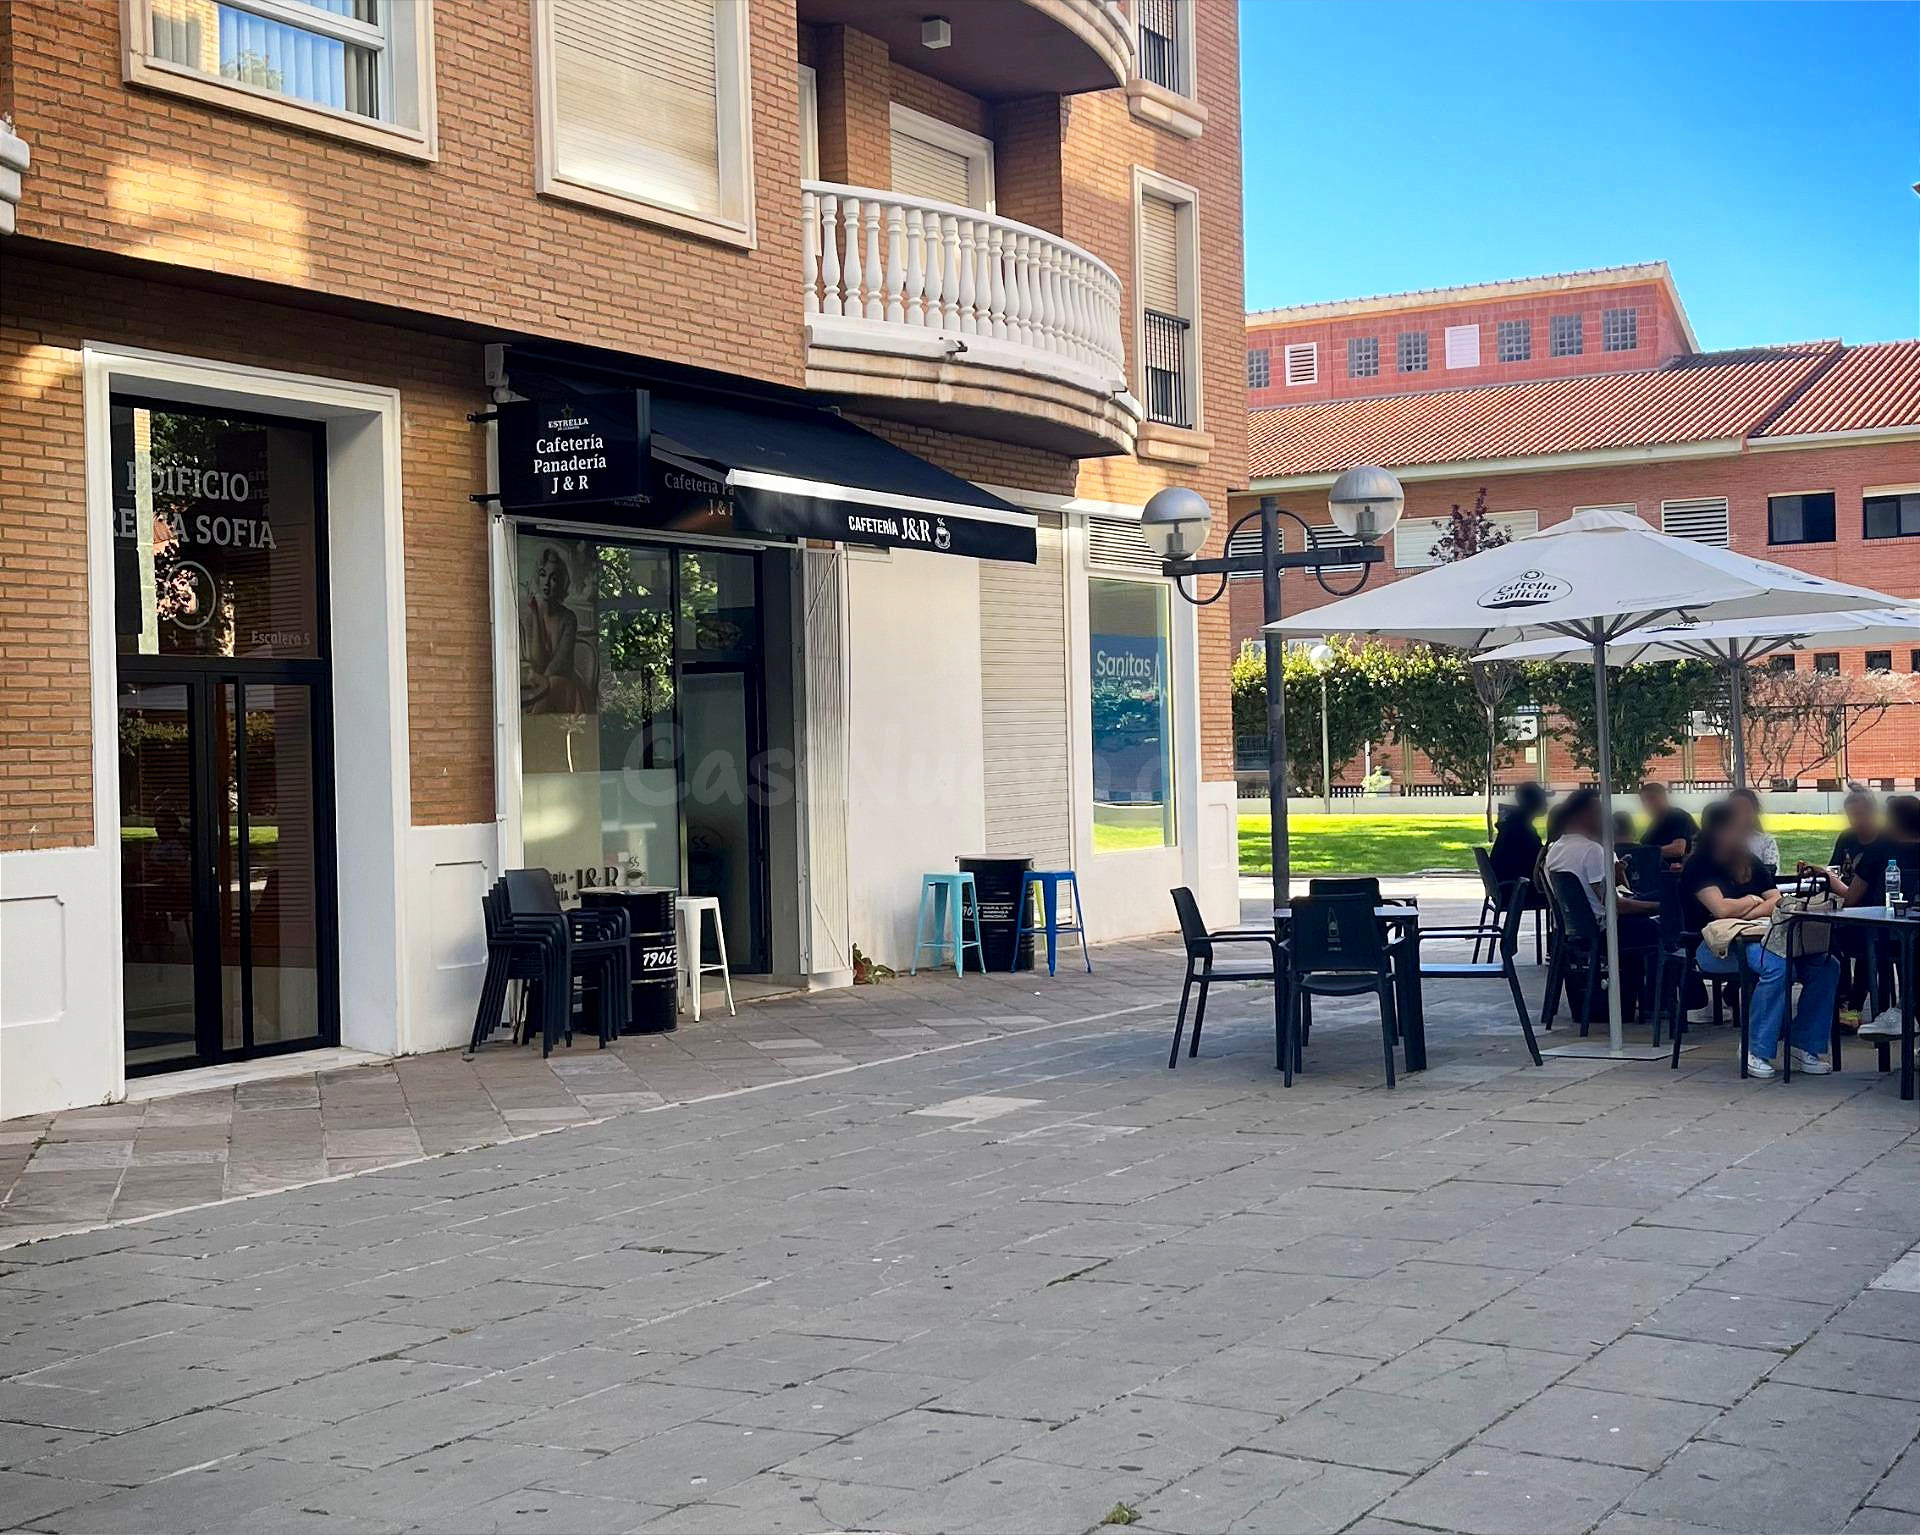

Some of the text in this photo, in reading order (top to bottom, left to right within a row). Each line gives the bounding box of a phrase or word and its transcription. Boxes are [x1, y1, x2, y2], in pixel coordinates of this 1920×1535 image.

[548, 418, 588, 428] ESTRELLA
[536, 434, 603, 453] Cafetería
[534, 453, 606, 473] Panadería
[551, 475, 588, 494] J & R
[196, 514, 277, 550] SOFIA
[848, 515, 931, 542] CAFETERÍA J&R
[1096, 650, 1151, 677] Sanitas
[643, 950, 673, 967] 1906
